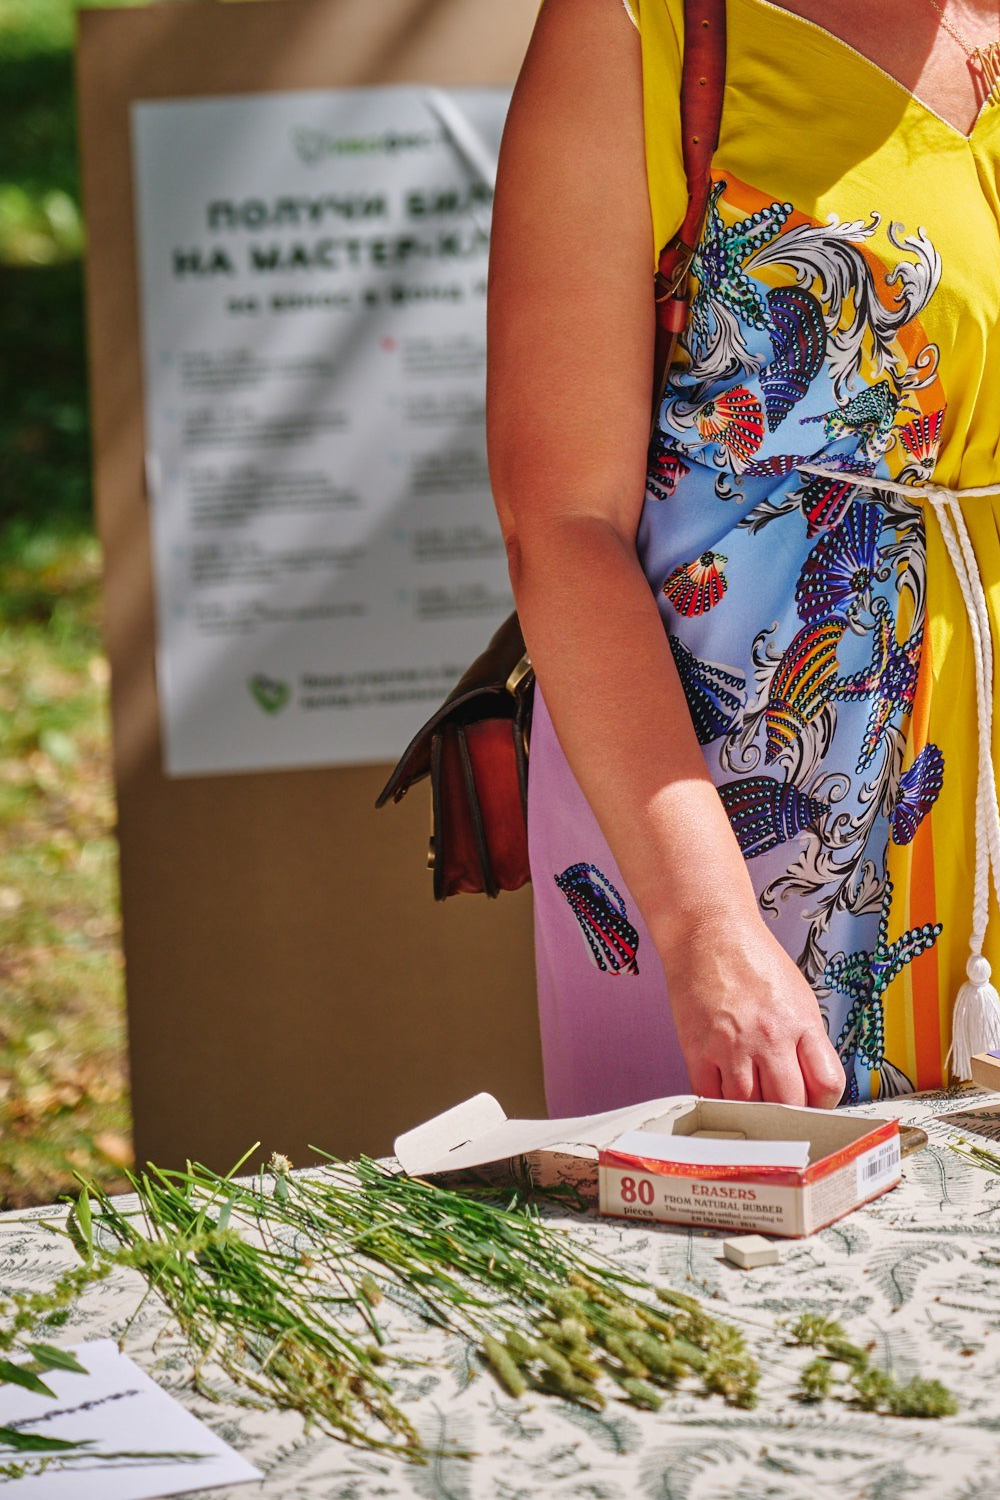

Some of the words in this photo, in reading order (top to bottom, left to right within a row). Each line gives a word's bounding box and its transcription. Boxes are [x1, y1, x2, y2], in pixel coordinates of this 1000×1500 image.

[207, 192, 388, 230] ПОЛУЧИ
[172, 246, 232, 278] НА
[620, 1177, 655, 1205] 80
[691, 1184, 757, 1201] ERASERS
[624, 1206, 654, 1217] pieces
[664, 1195, 692, 1205] FROM
[694, 1199, 740, 1211] NATURAL
[742, 1204, 783, 1214] RUBBER
[678, 1208, 706, 1217] company
[715, 1211, 741, 1219] certified
[742, 1214, 775, 1223] according
